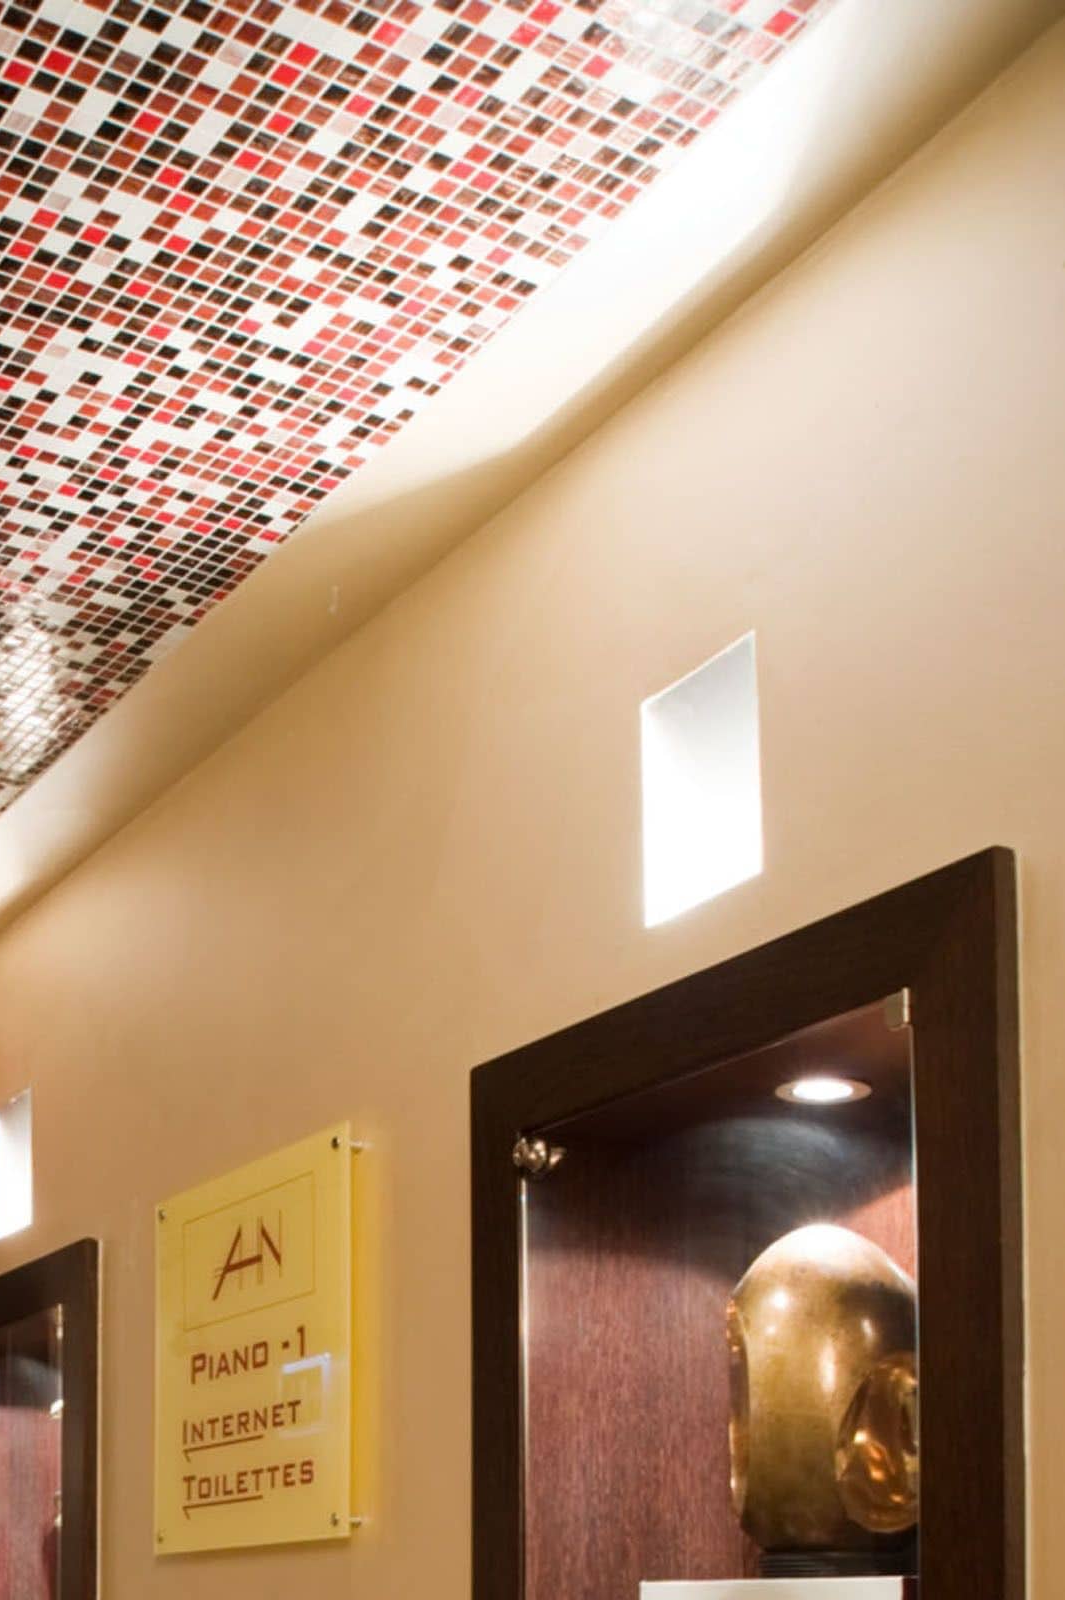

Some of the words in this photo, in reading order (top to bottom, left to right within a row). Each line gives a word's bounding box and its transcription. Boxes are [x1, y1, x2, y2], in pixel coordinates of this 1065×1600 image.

[190, 1340, 269, 1384] PIANO
[183, 1400, 302, 1445] INTERNET
[183, 1459, 315, 1501] TOILETTES
